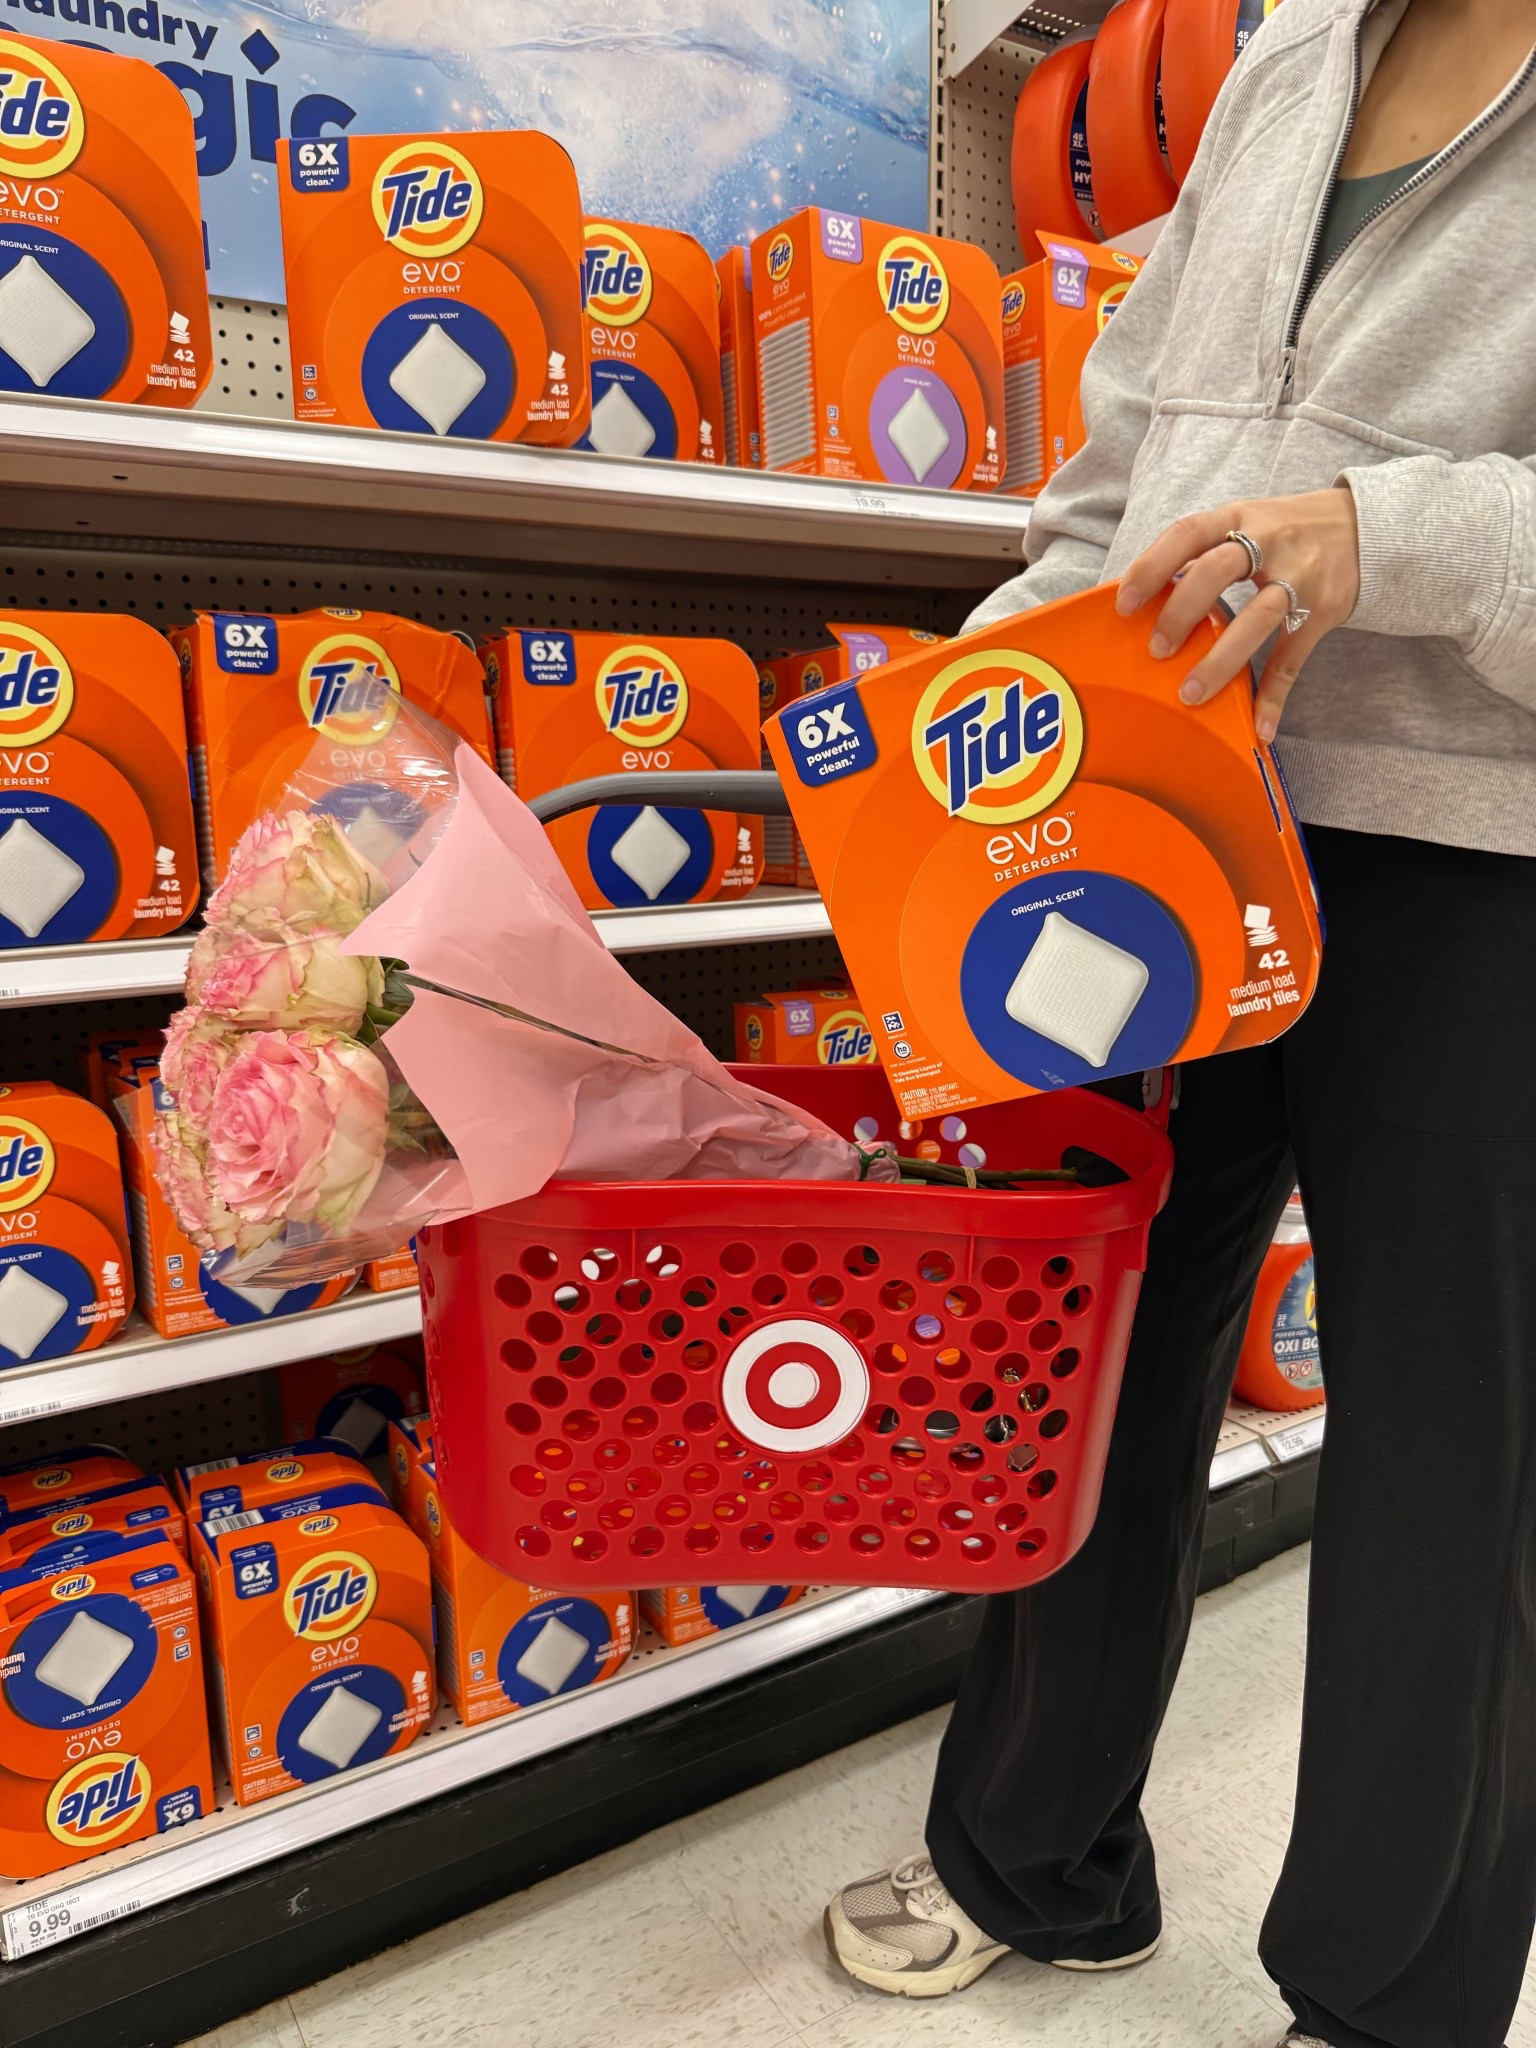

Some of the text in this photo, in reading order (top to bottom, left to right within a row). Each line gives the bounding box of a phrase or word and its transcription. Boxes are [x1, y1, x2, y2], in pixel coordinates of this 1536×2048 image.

[6, 0, 219, 60] aundry
[298, 143, 339, 166] 6X
[300, 167, 340, 178] powerful
[381, 167, 473, 241] Tide
[827, 217, 855, 240] 6X
[0, 240, 59, 255] RIGINAL SCENT
[828, 239, 856, 250] powerful
[769, 242, 791, 276] Tide
[884, 258, 943, 314] Tide
[1057, 267, 1083, 289] 6X
[403, 285, 461, 294] DETERGENT
[440, 312, 459, 320] SCENT
[173, 349, 195, 362] 42
[592, 347, 636, 359] DETERGENT
[898, 354, 936, 366] DETERGENT
[151, 364, 196, 377] medium load
[147, 375, 197, 389] laundry tiles
[551, 384, 569, 396] 42
[531, 399, 570, 410] medium load
[527, 410, 570, 421] laundry tiles
[702, 448, 715, 459] 42
[987, 453, 998, 464] 42
[225, 624, 268, 649] 6X
[227, 649, 269, 660] powerful
[530, 641, 567, 663] 6X
[531, 663, 568, 672] powerful
[855, 652, 882, 672] 6X
[604, 669, 680, 732] Tide
[797, 702, 856, 749] 6X
[806, 736, 860, 767] powerful
[922, 678, 1063, 818] Tide
[26, 806, 50, 814] SCENT
[739, 854, 754, 865] 42
[993, 847, 1079, 882] DETERGENT
[160, 879, 181, 892] 42
[138, 894, 182, 907] medium load
[1011, 887, 1085, 916] ORIGINAL SCENT
[134, 905, 182, 919] laundry tiles
[1258, 949, 1290, 970] 42
[1229, 970, 1296, 1000] medium load
[1227, 989, 1300, 1018] laundry tiles
[790, 1009, 810, 1024] 6X
[823, 1024, 872, 1065] Tide
[900, 1087, 928, 1101] CAUTION:
[109, 1286, 122, 1297] 16
[1273, 1339, 1299, 1355] OXI
[37, 1470, 68, 1486] Tide
[271, 1463, 300, 1478] Tide
[57, 1513, 89, 1532] Tide
[304, 1516, 335, 1532] Tide
[241, 1560, 271, 1581] 6X
[56, 1574, 90, 1597] Tide
[242, 1577, 273, 1591] powerful
[291, 1566, 368, 1637] Tide
[311, 1652, 360, 1672] DETERGENT
[311, 1671, 363, 1692] ORIGINAL SCENT
[416, 1693, 429, 1703] 16
[61, 1698, 121, 1723] ORIGINAL SCENT
[66, 1719, 121, 1743] DETERGENT
[56, 1754, 144, 1832] Tide
[164, 1803, 195, 1826] 6X
[25, 1900, 48, 1915] TIDE
[37, 1908, 49, 1918] EVO
[29, 1909, 71, 1938] 9.99
